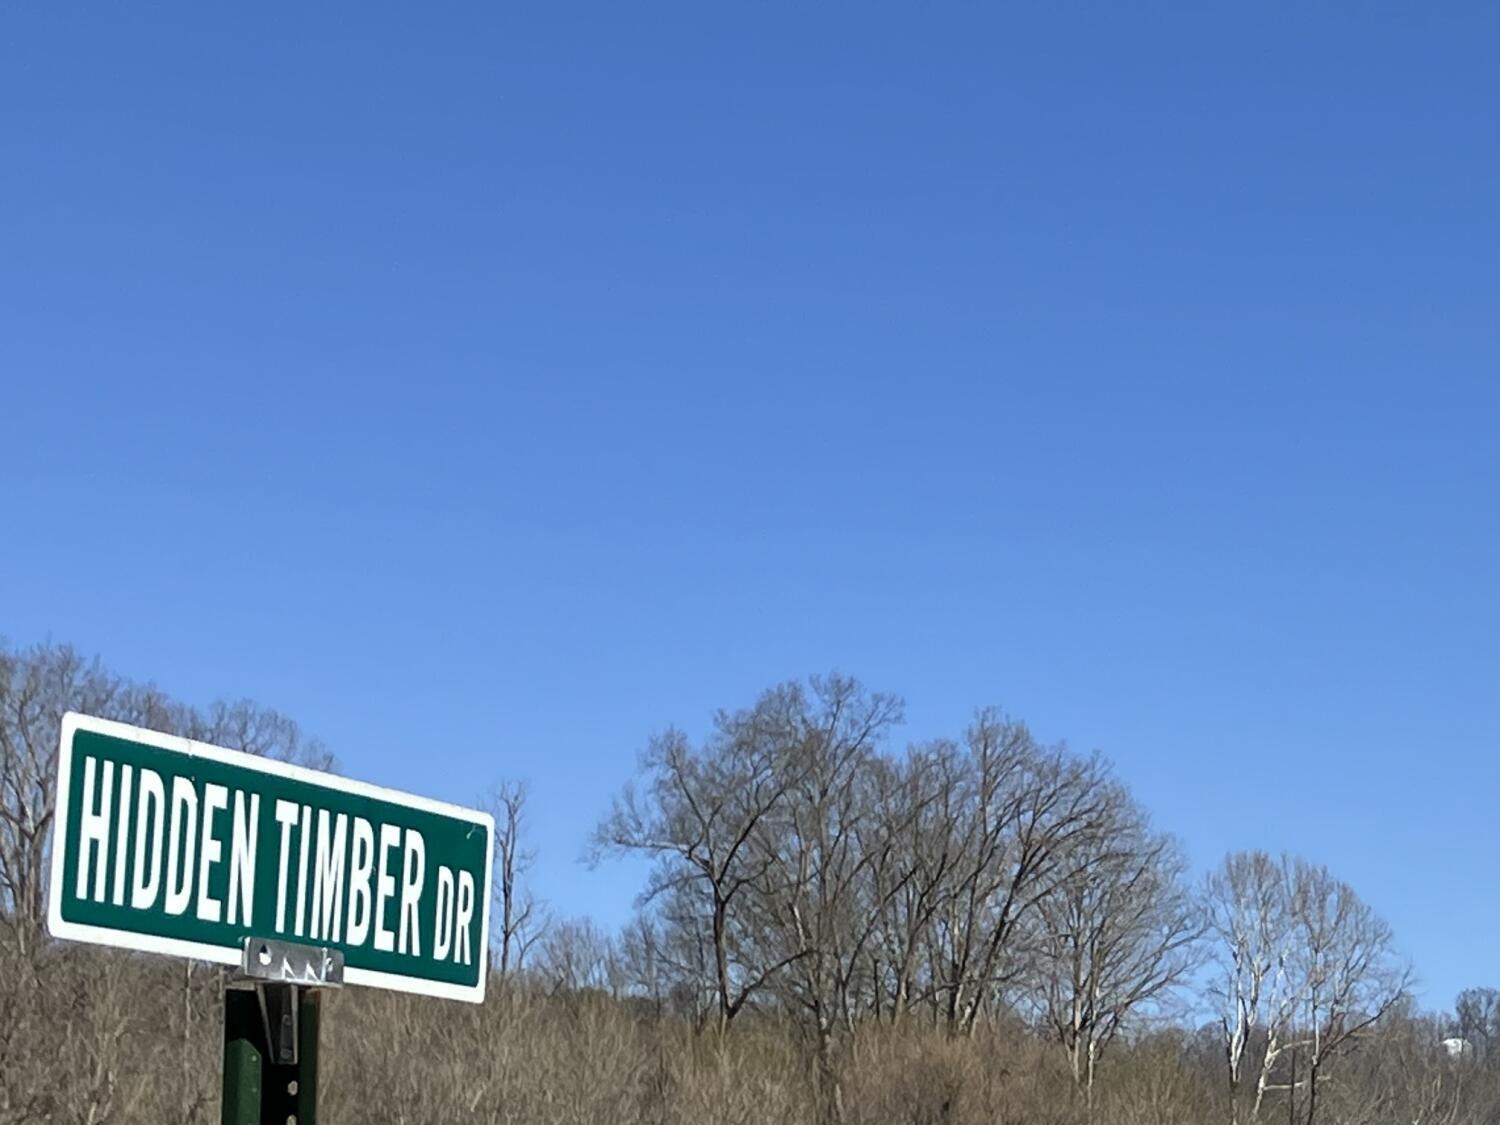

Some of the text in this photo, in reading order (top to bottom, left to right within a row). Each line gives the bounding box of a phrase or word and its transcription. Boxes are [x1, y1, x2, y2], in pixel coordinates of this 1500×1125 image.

[76, 756, 475, 966] HIDDEN TIMBER DR
